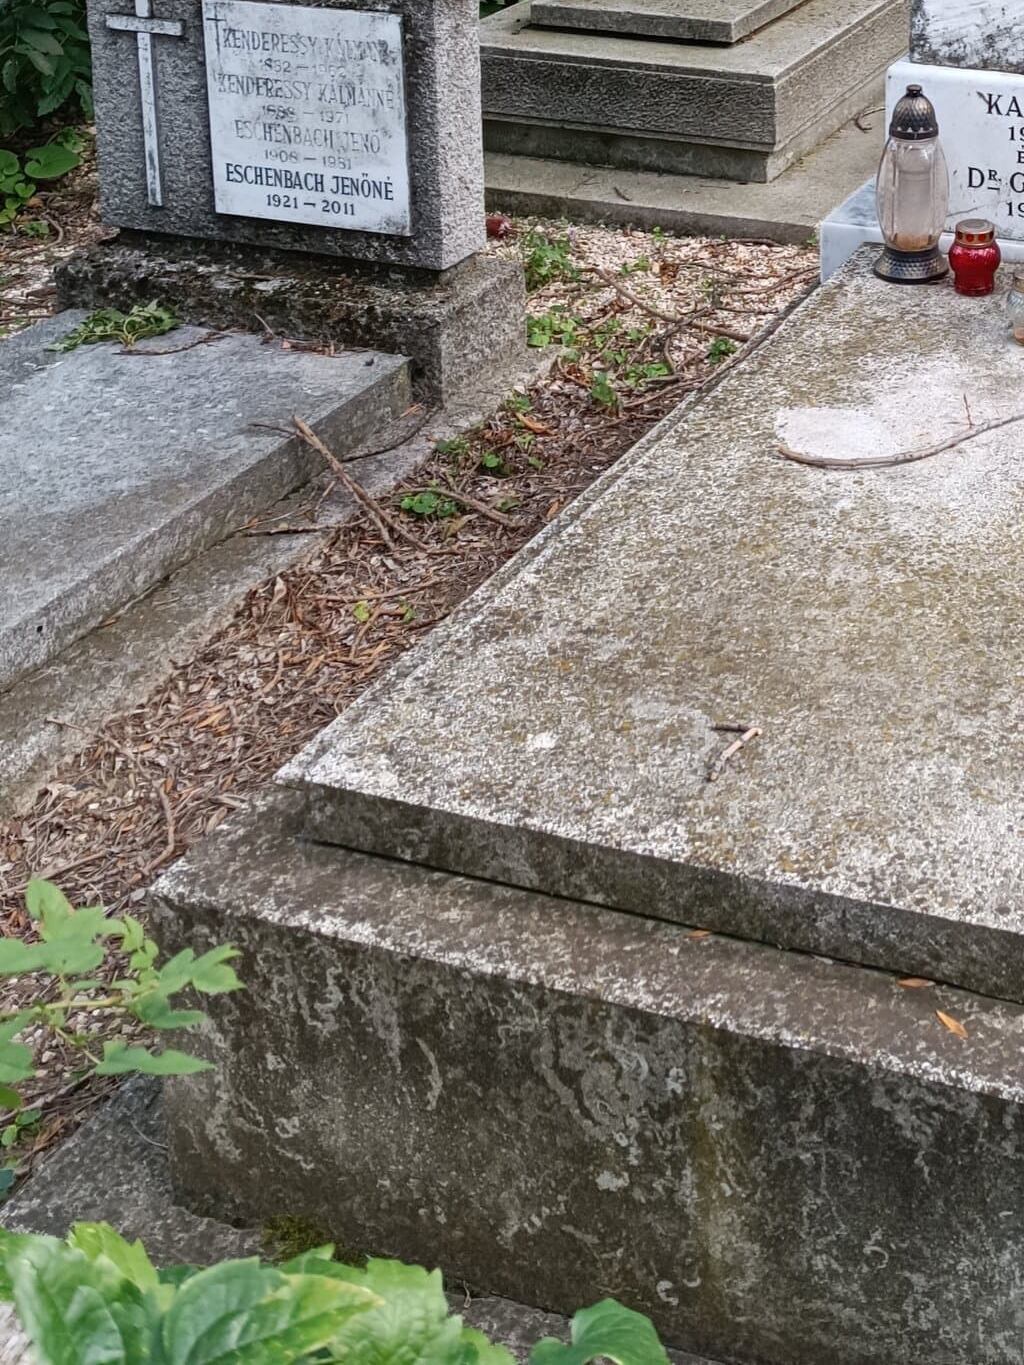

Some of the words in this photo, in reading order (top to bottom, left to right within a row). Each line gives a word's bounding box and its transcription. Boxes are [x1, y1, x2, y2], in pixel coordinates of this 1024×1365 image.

[234, 119, 334, 149] ESCHENBACH
[226, 163, 324, 193] ESCHENBACH
[266, 194, 298, 209] 1921
[322, 200, 356, 216] 2011
